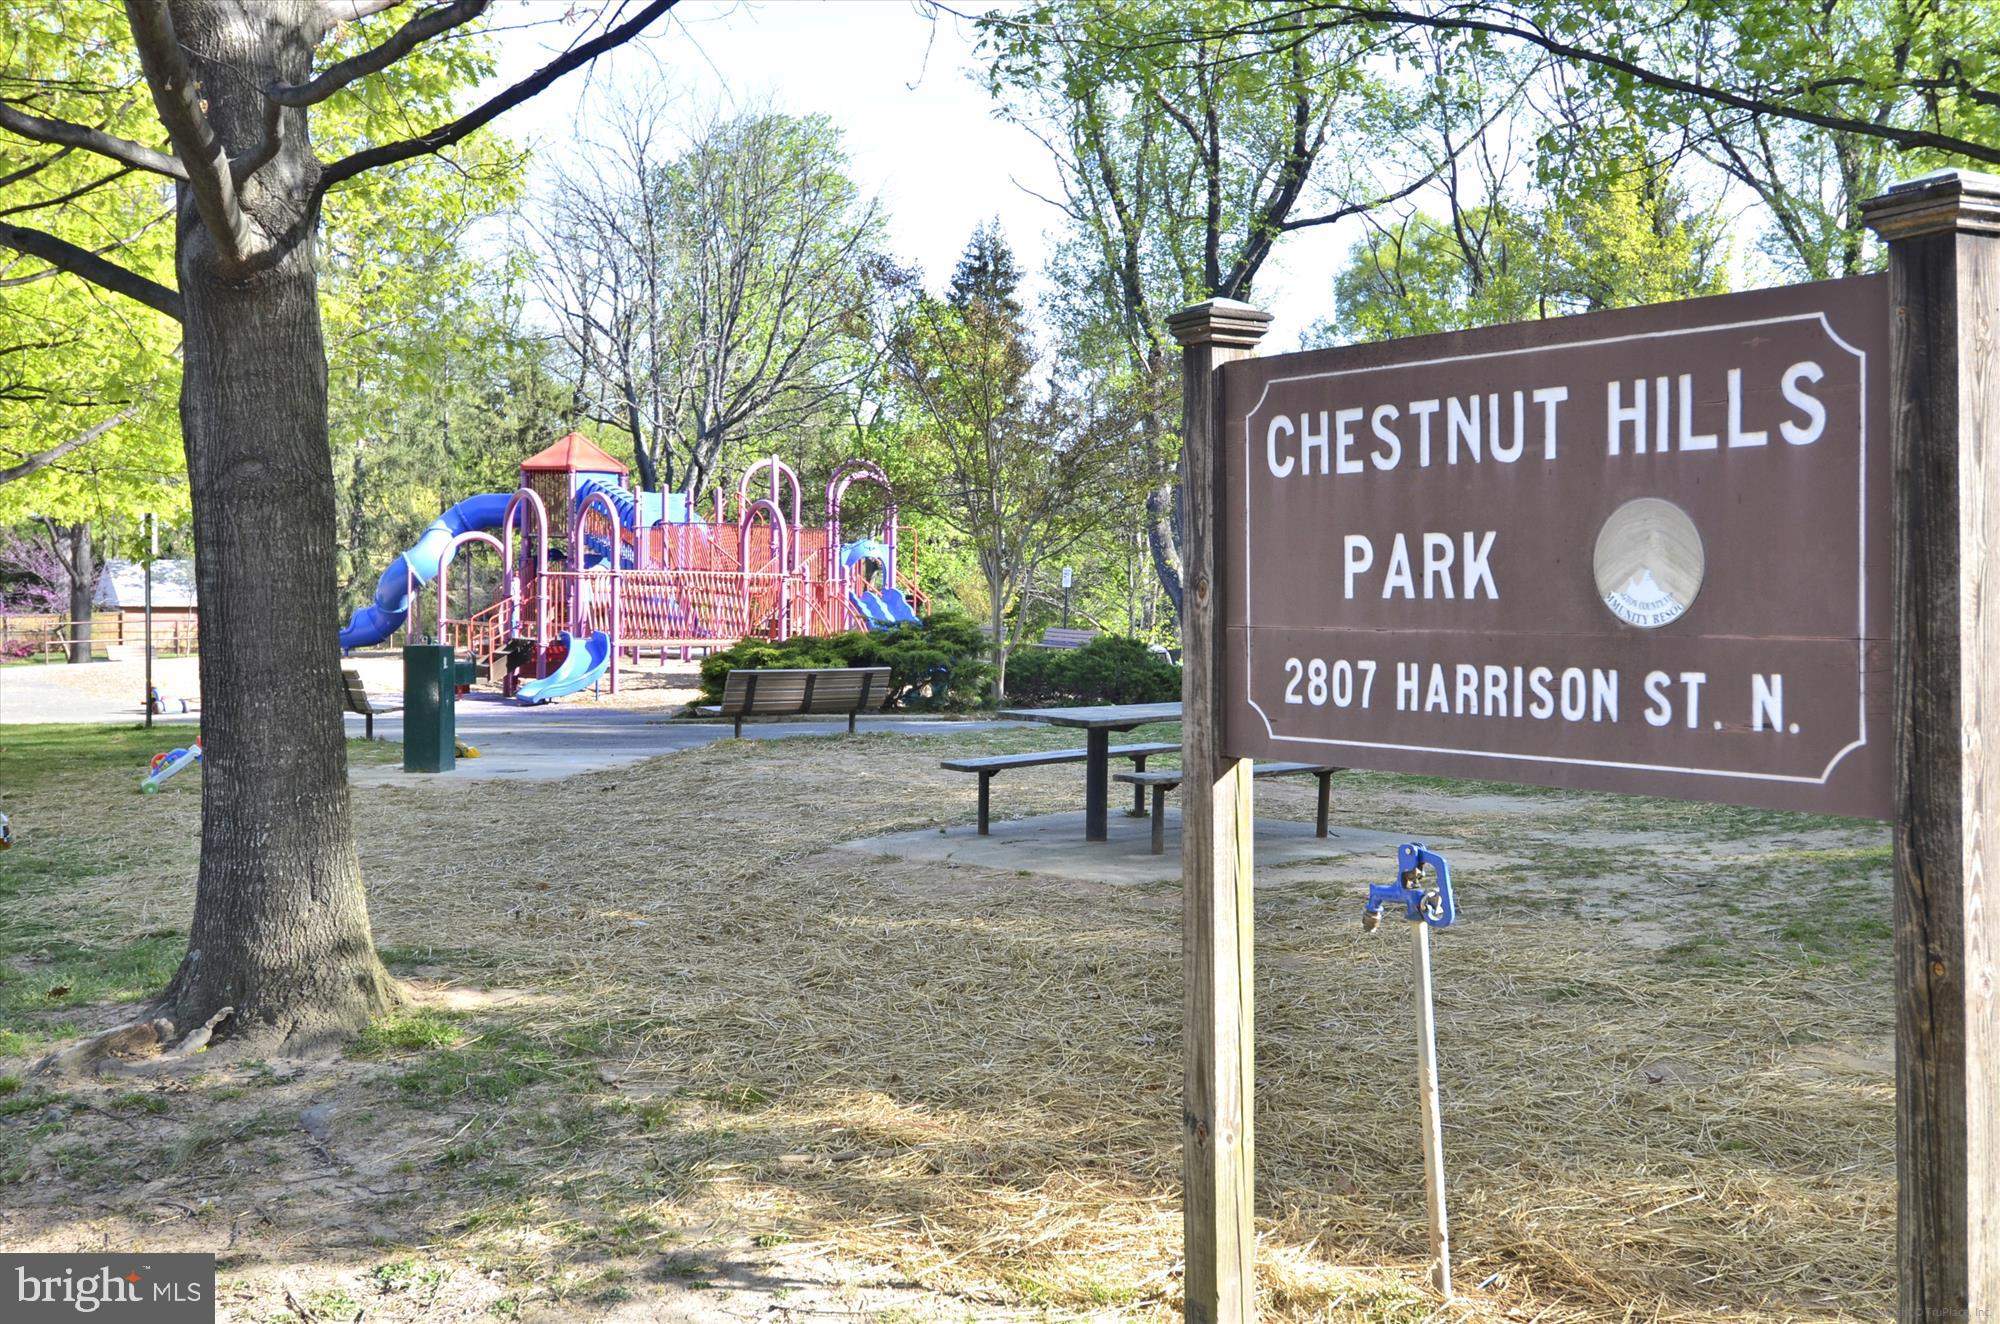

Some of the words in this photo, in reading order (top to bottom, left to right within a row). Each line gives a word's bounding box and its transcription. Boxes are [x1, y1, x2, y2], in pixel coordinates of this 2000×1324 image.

[1267, 386, 1568, 478] CHESTNUT
[1607, 361, 1826, 456] HILLS
[1344, 531, 1499, 599] PARK
[1285, 657, 1377, 709] 2807
[1397, 662, 1618, 723] HARRISON
[1644, 670, 1722, 731] ST.
[1752, 672, 1799, 735] N.
